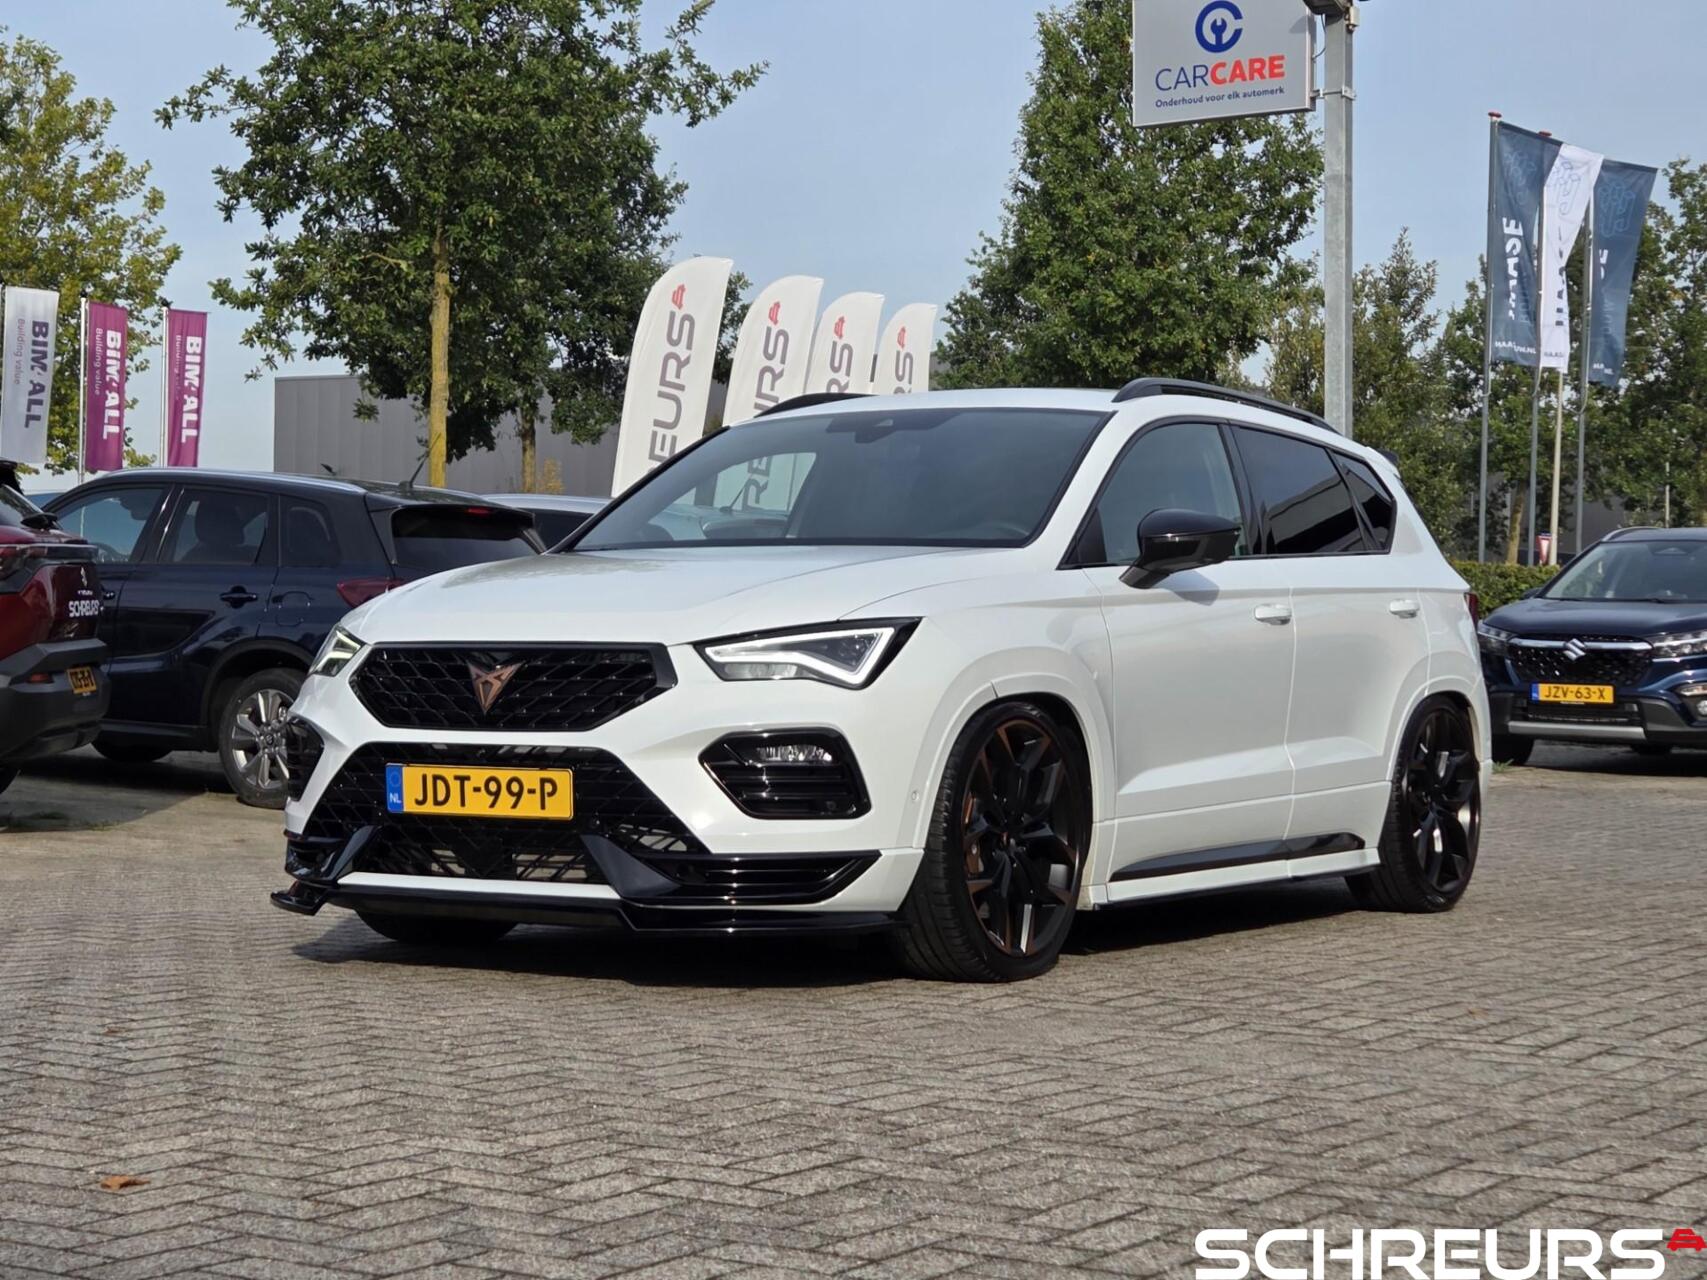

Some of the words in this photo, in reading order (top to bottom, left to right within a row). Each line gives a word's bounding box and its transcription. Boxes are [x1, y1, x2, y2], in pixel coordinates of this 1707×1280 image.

[1155, 55, 1285, 91] CARCARE
[1155, 95, 1203, 108] Onderhoud
[1205, 94, 1225, 102] voor
[1227, 90, 1241, 100] elk
[1242, 86, 1285, 98] automerk
[15, 319, 25, 360] Building
[94, 328, 103, 368] Building
[15, 361, 24, 385] value
[1545, 686, 1605, 700] JZV-63-X
[389, 792, 402, 803] NL
[414, 773, 558, 811] JDT-99-P
